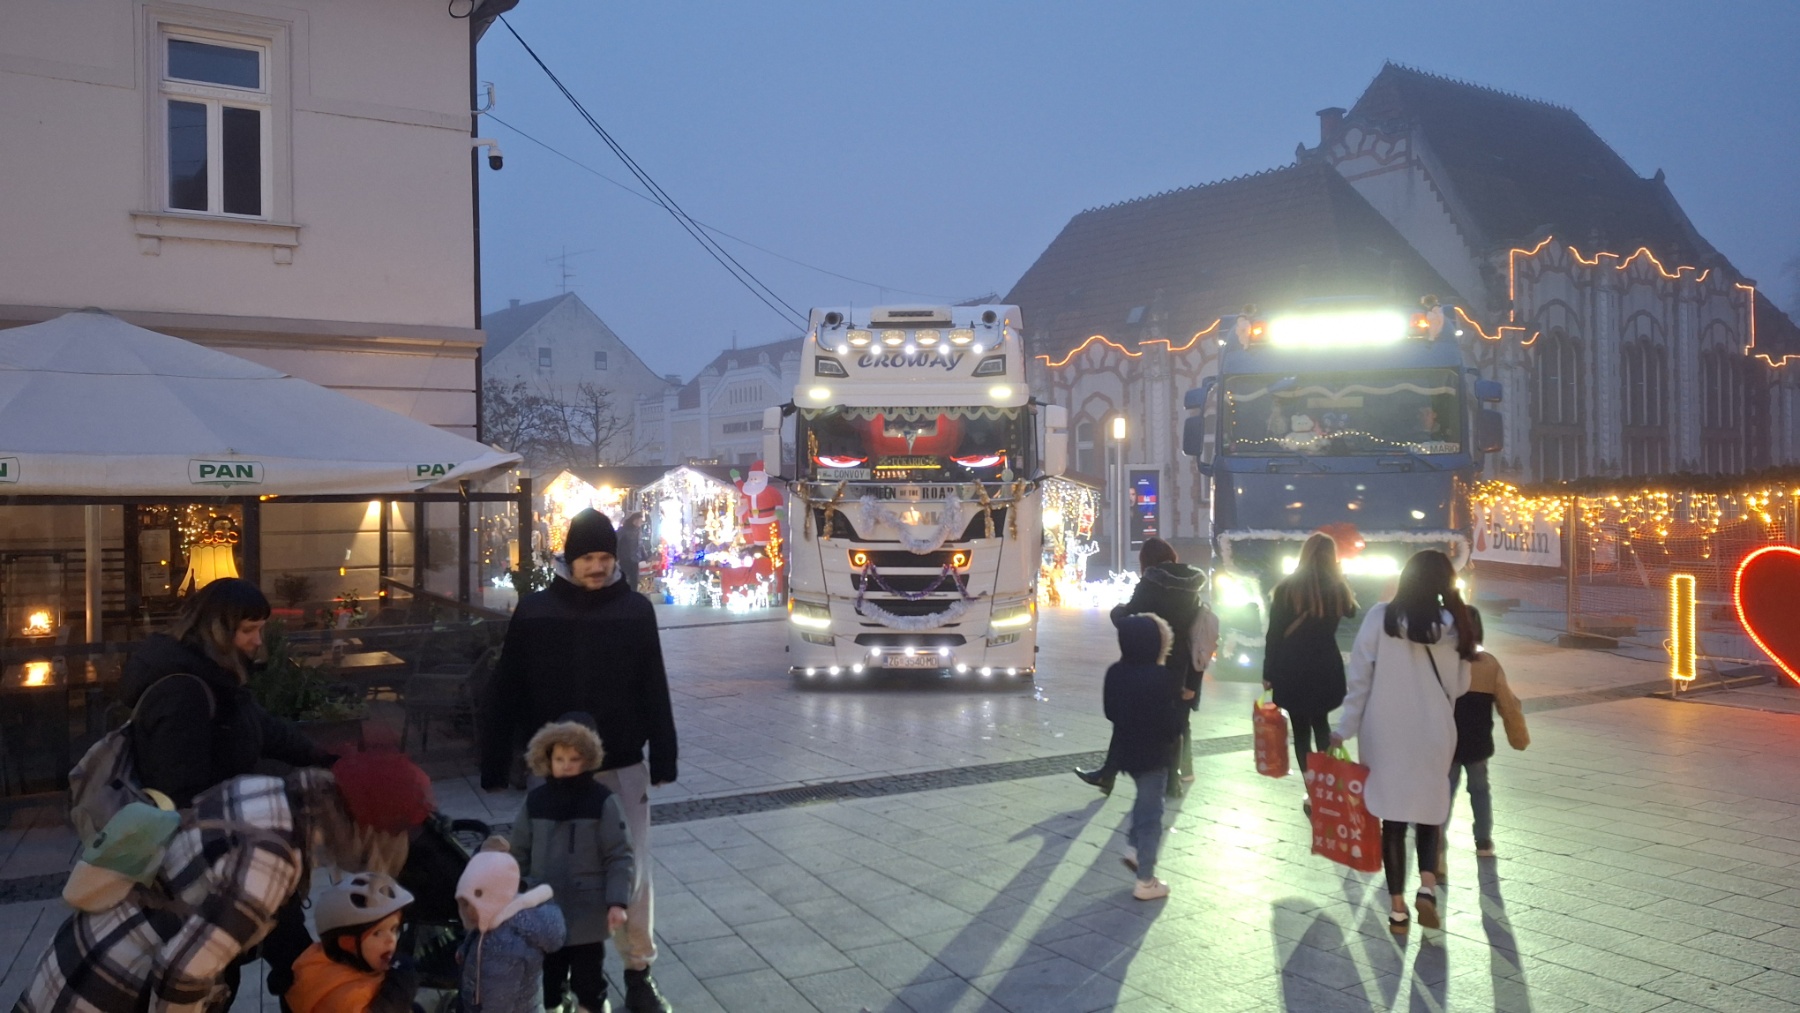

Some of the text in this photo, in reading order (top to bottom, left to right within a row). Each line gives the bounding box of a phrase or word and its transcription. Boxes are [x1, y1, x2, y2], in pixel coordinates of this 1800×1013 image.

[200, 464, 253, 478] PAN
[417, 463, 456, 476] PA
[834, 469, 864, 478] CONVOY
